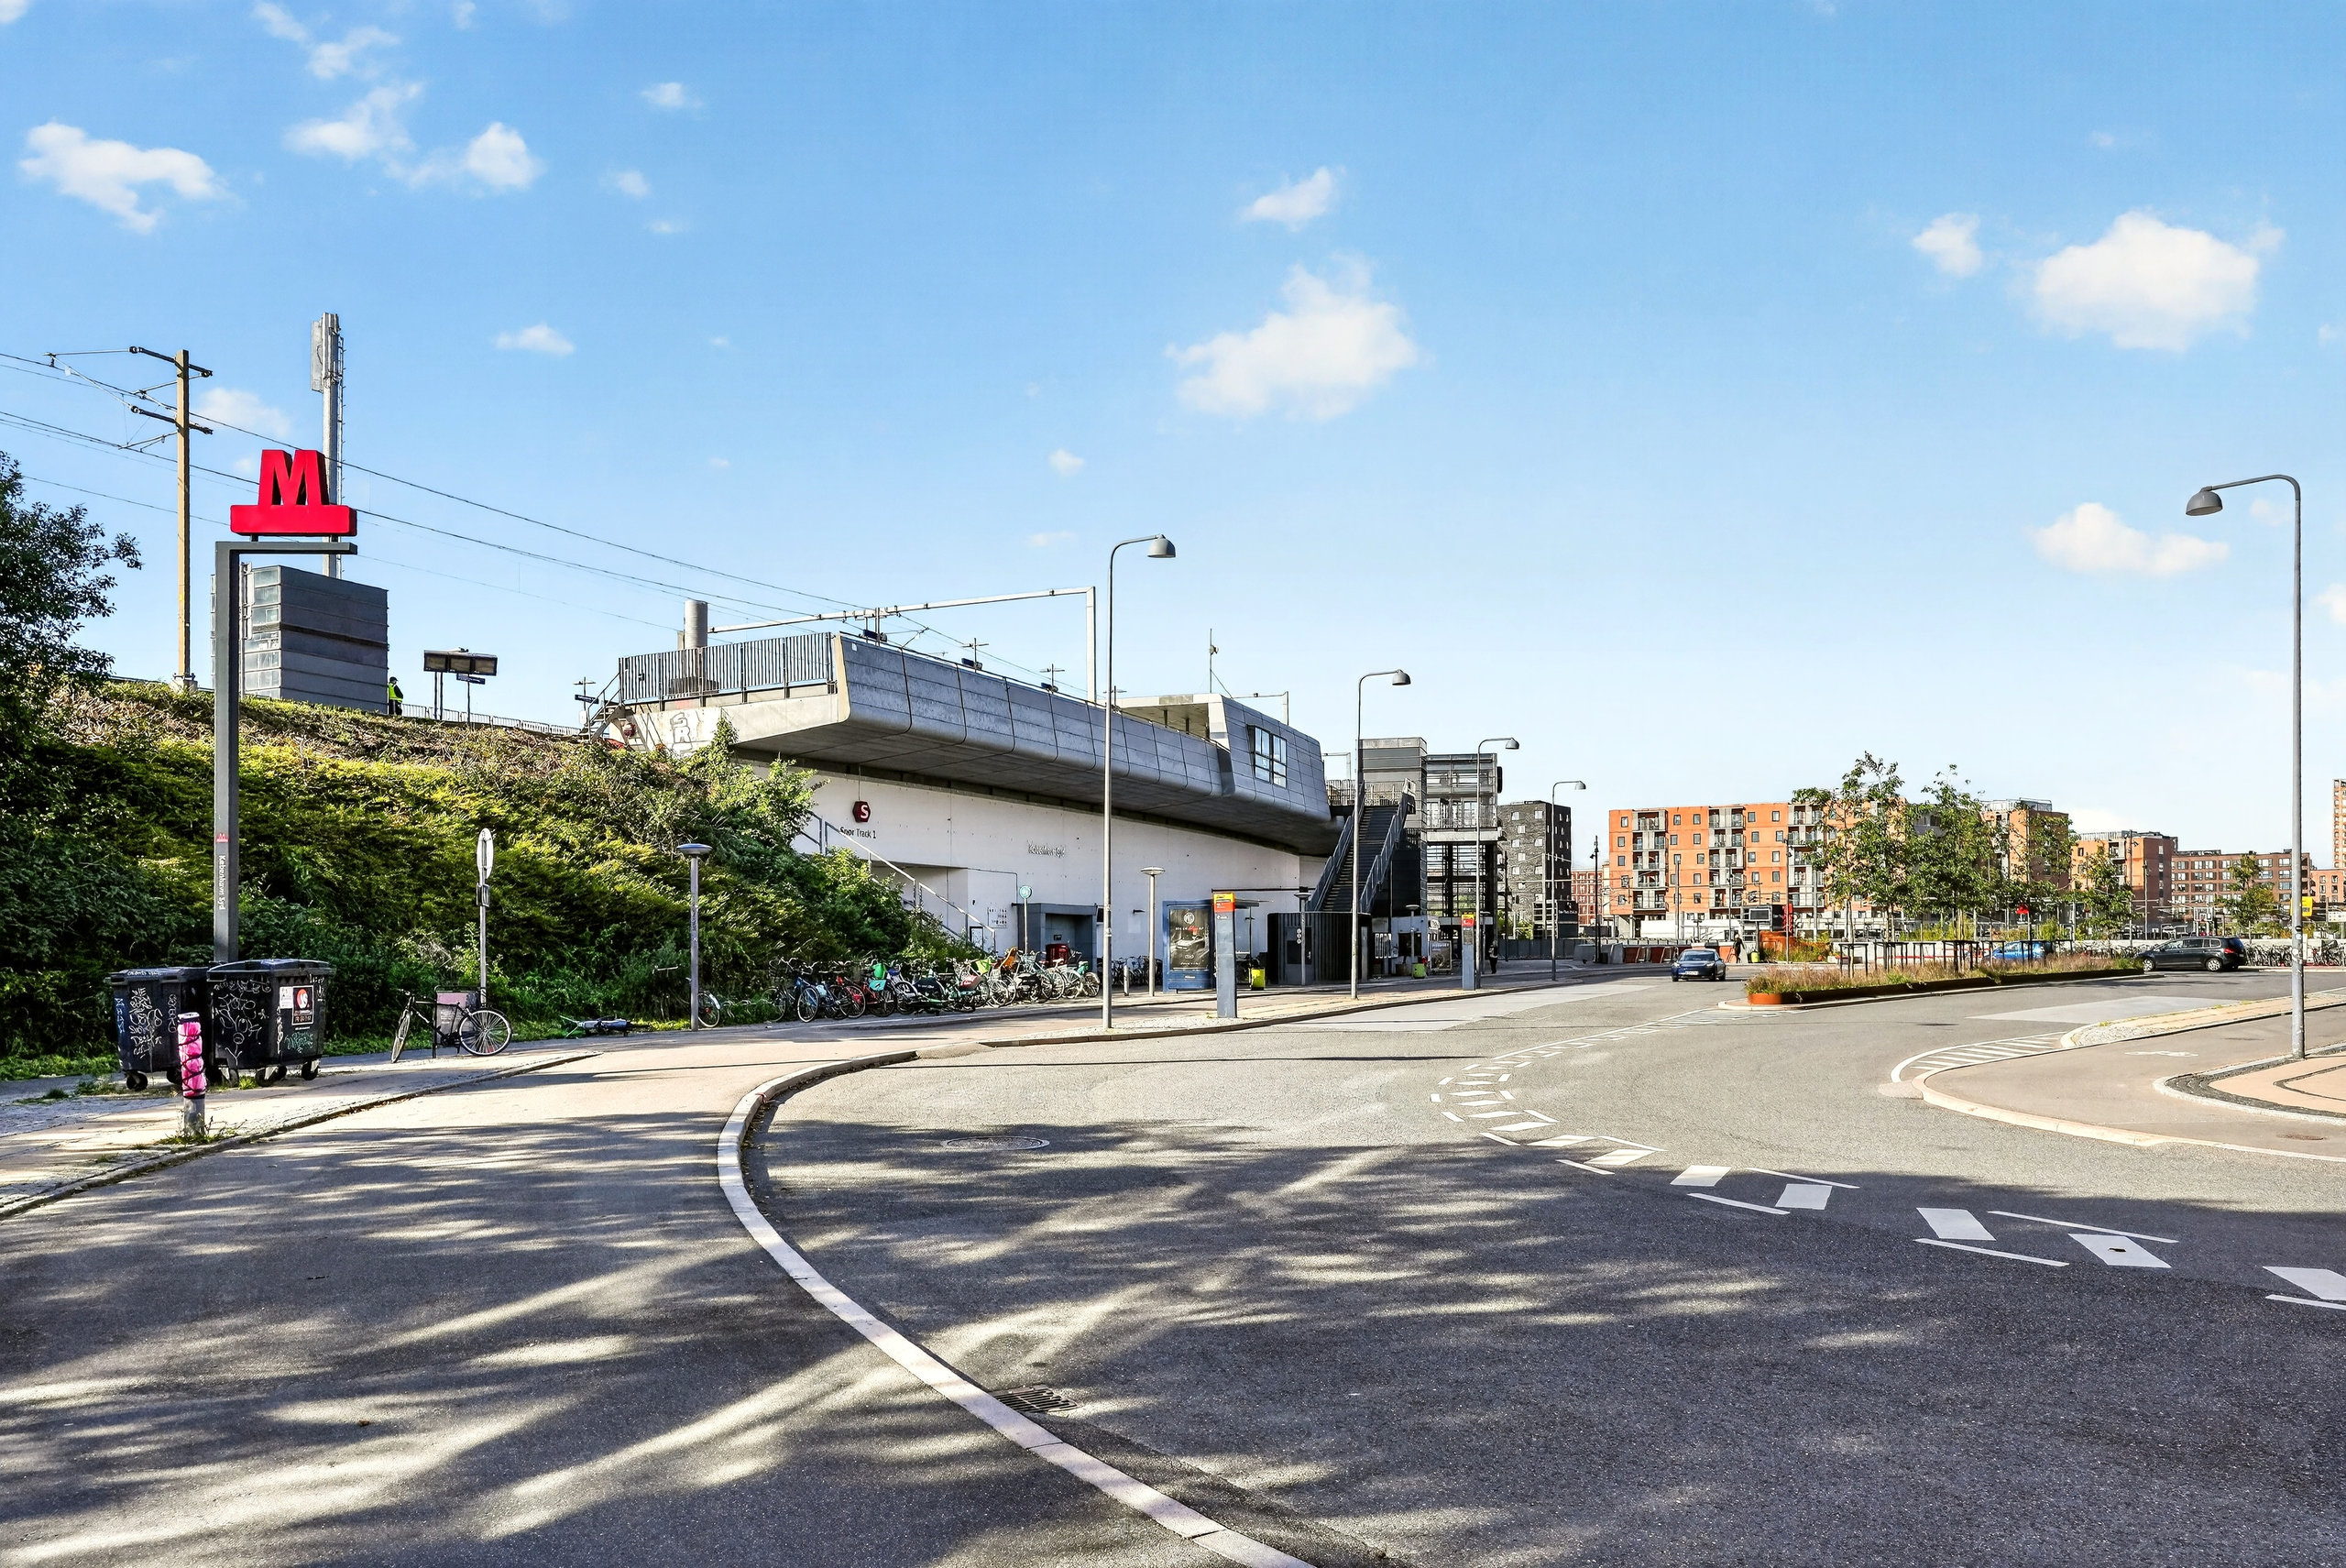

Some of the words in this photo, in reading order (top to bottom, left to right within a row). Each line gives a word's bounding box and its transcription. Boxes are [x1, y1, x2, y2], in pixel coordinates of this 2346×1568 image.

[861, 805, 869, 819] S
[856, 828, 872, 839] Track
[872, 830, 876, 839] 1
[217, 897, 226, 910] Syd
